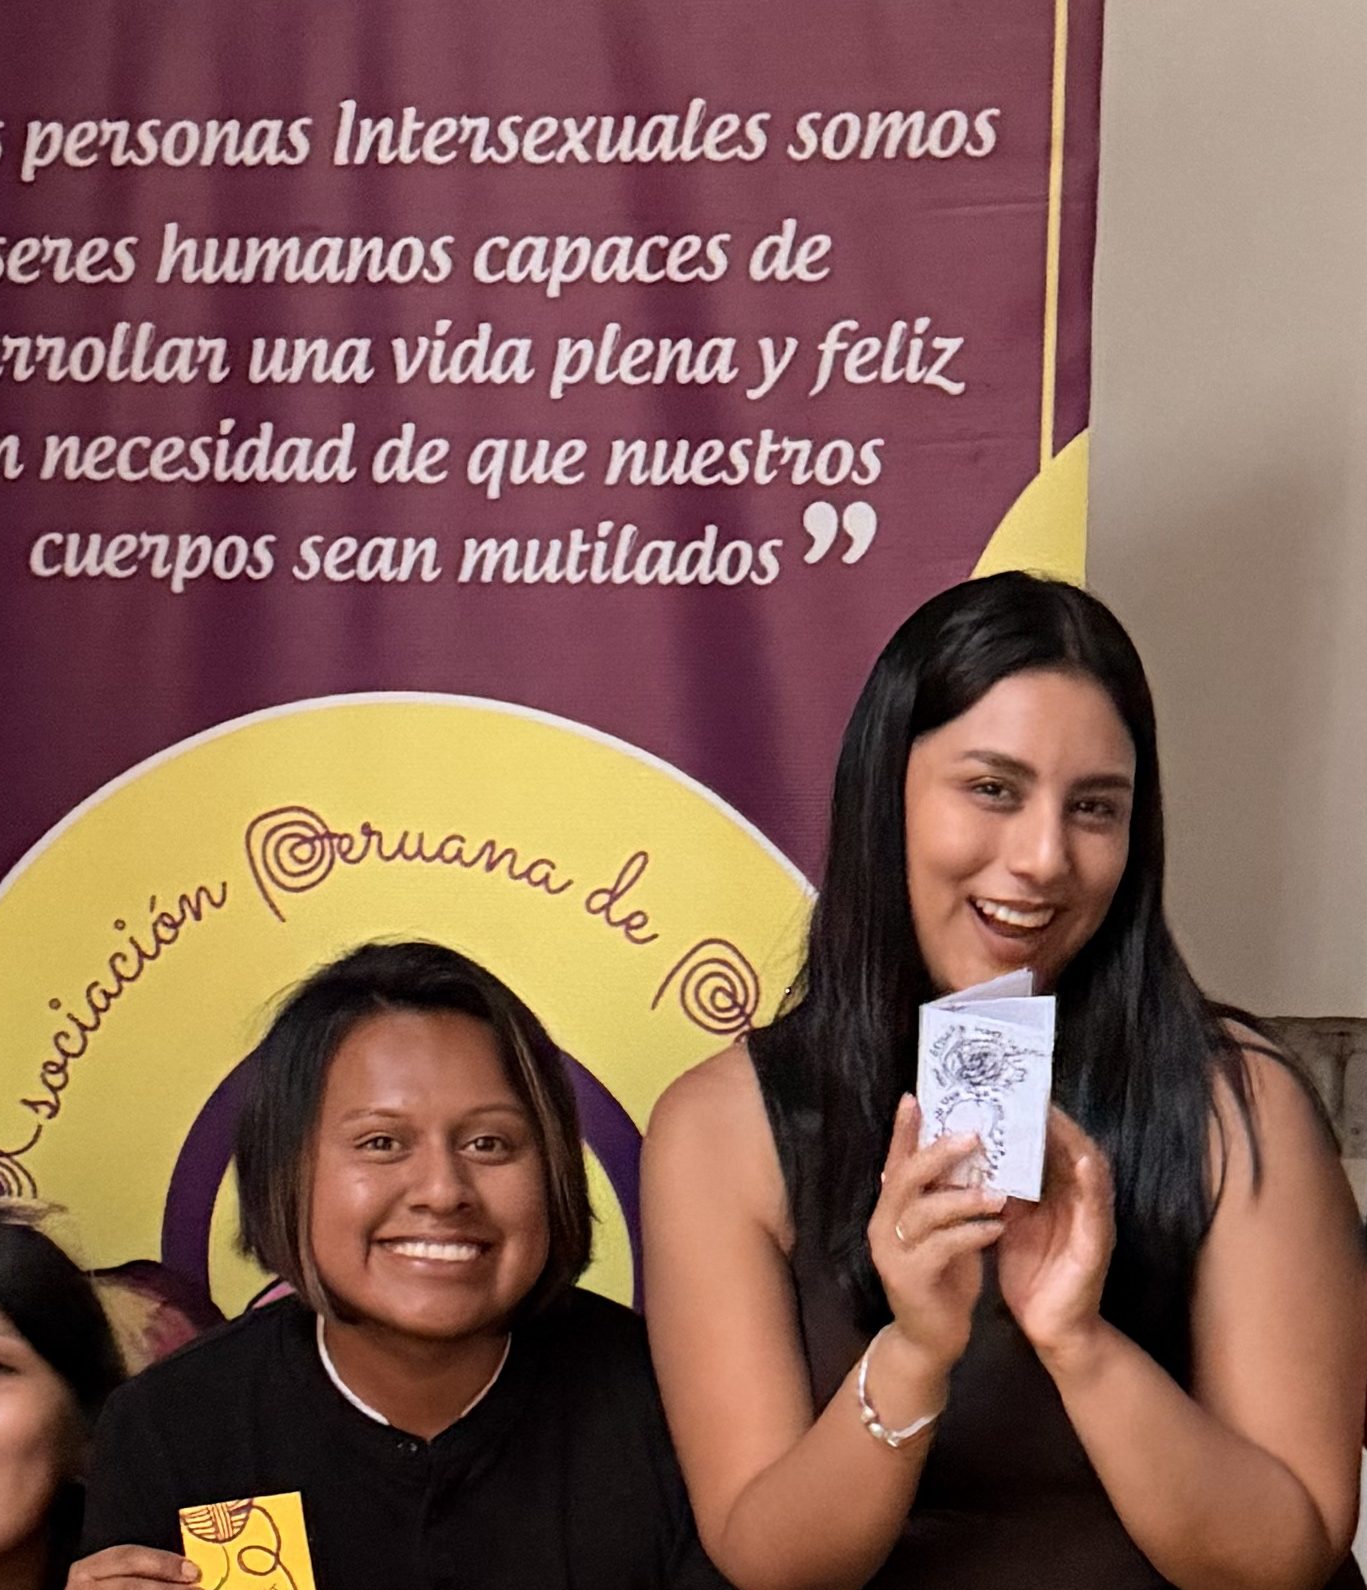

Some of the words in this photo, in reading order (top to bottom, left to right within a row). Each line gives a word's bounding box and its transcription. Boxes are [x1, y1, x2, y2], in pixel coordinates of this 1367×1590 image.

[20, 116, 313, 182] personas
[333, 97, 771, 167] Intersexuales
[786, 106, 1002, 161] somos
[156, 221, 455, 284] humanos
[473, 234, 731, 298] capaces
[749, 216, 832, 283] de
[249, 336, 375, 384] una
[391, 318, 536, 385] vida
[548, 322, 739, 400] plena
[744, 336, 799, 400] y
[808, 315, 967, 397] feliz
[41, 417, 357, 483] necesidad
[372, 422, 450, 484] de
[466, 438, 588, 501] que
[604, 428, 885, 487] nuestros
[29, 532, 276, 593] cuerpos
[292, 535, 442, 582] sean
[245, 804, 574, 924] Peruana
[584, 849, 660, 946] de
